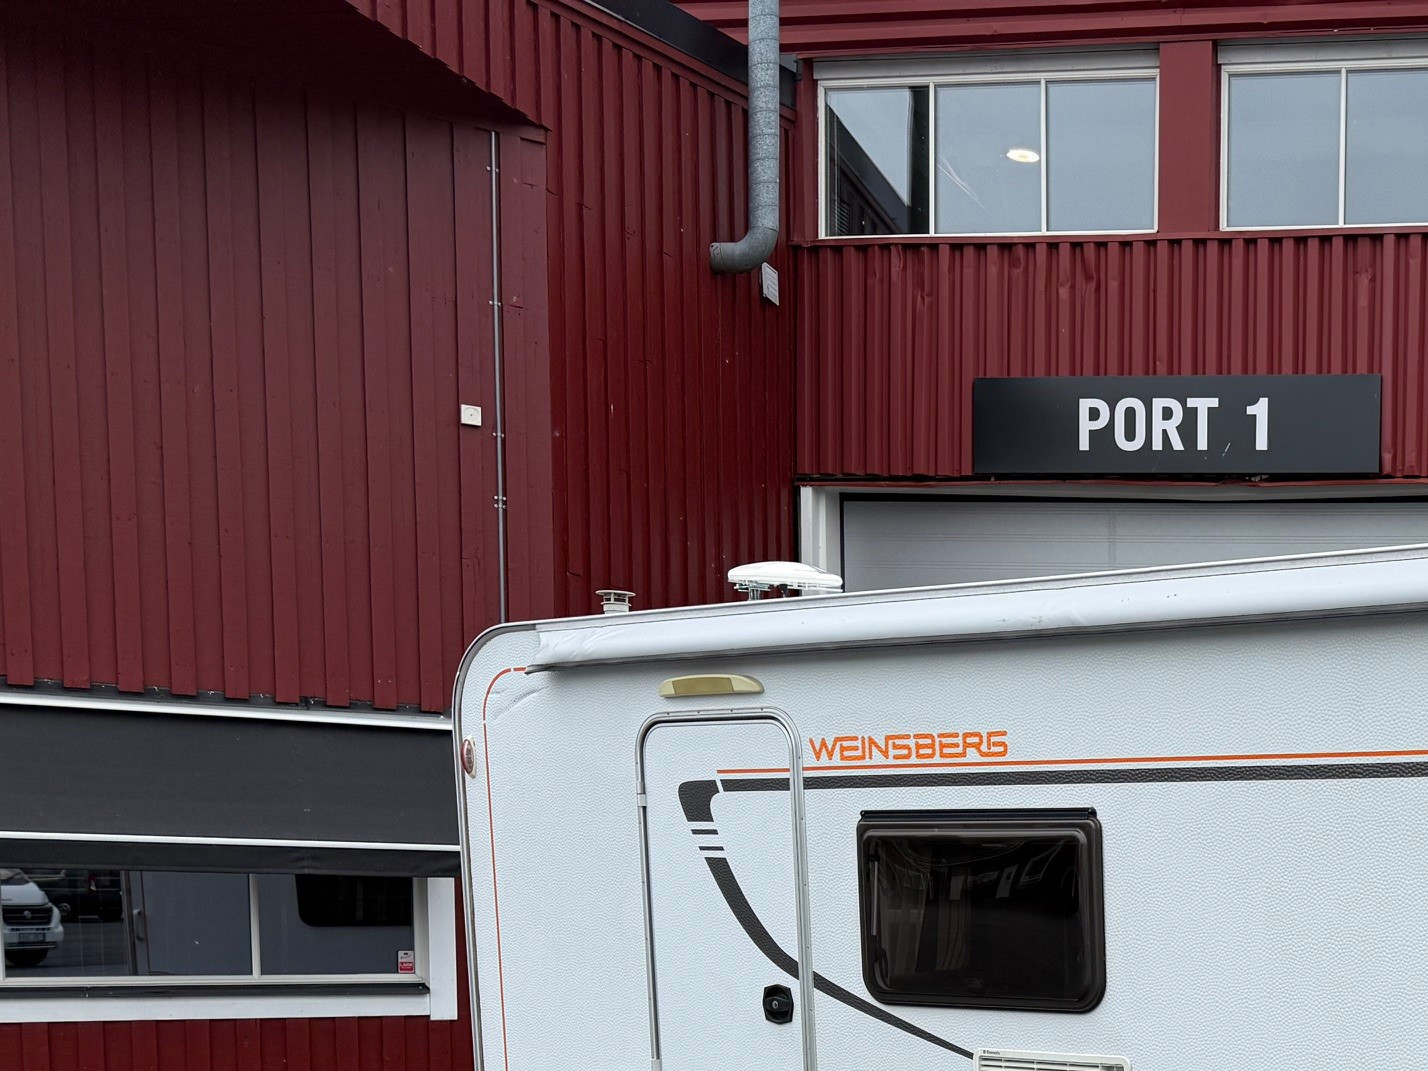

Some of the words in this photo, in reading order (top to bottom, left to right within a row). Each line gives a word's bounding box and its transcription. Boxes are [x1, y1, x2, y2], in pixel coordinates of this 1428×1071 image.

[1078, 396, 1219, 452] PORT
[1246, 397, 1269, 451] 1
[808, 730, 1008, 762] WEINSBERG
